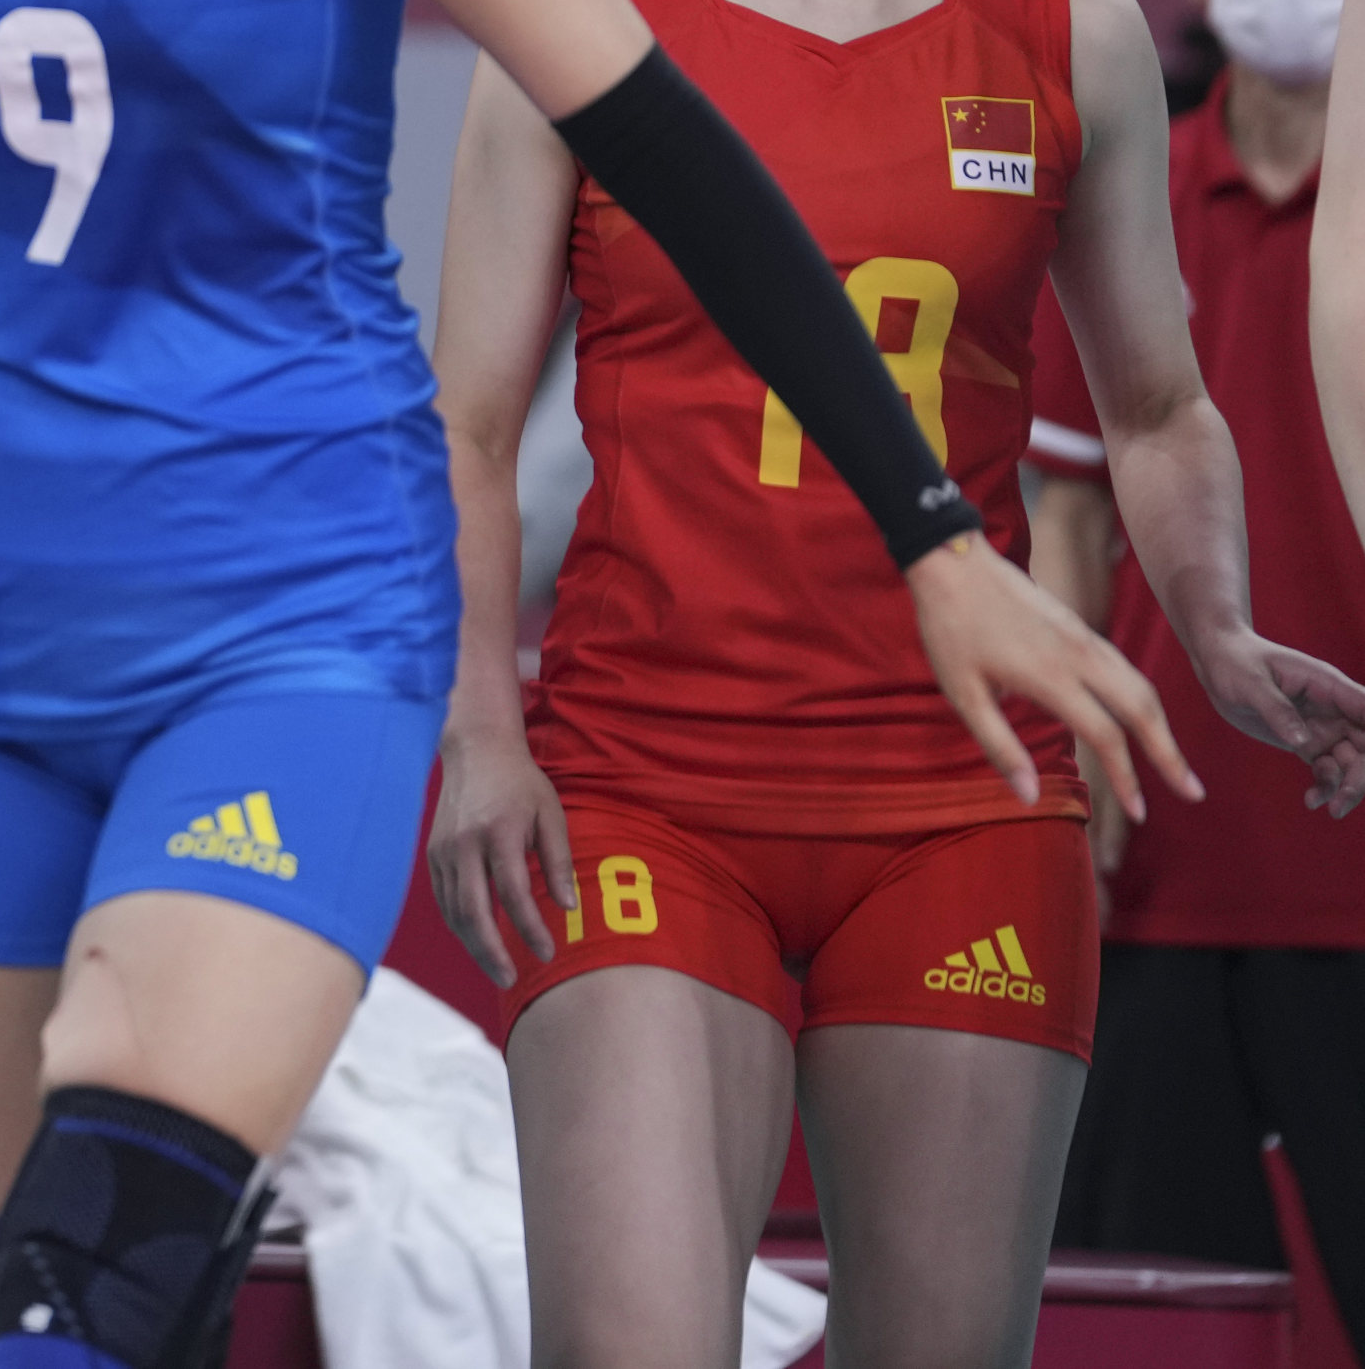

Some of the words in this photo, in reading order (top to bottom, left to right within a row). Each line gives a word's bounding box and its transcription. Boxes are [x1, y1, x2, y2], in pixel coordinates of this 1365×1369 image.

[962, 158, 1027, 185] CHN
[165, 836, 299, 881] adidas
[923, 965, 1047, 1006] adidas
